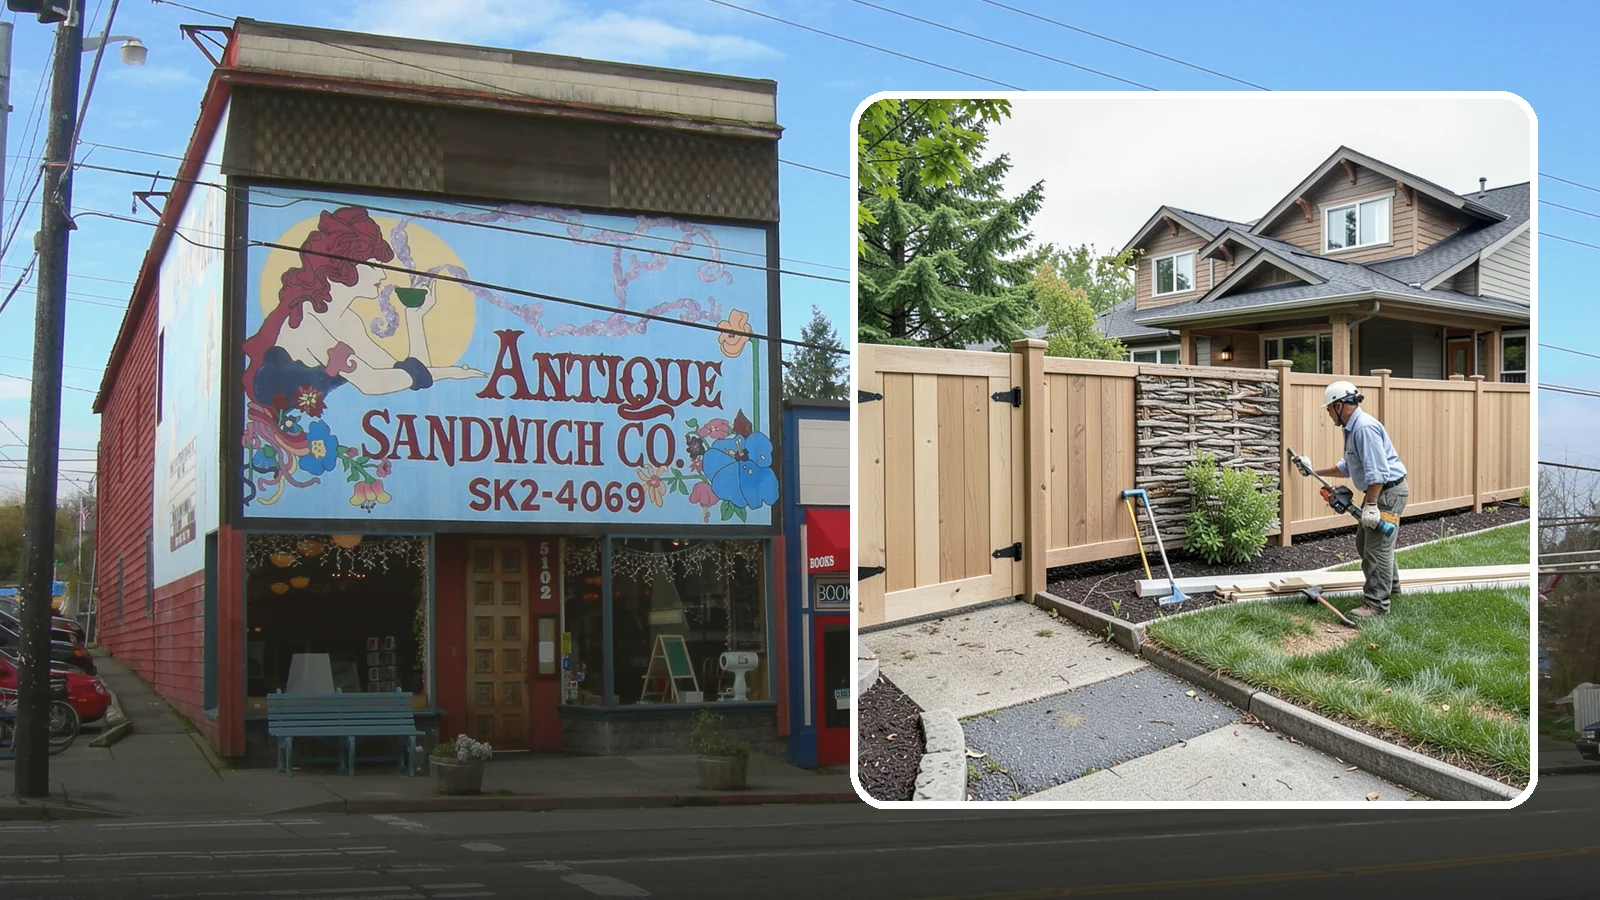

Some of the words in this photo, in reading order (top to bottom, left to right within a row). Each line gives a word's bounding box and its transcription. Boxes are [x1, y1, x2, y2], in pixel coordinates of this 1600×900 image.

[476, 330, 723, 420] ANTIQUE
[361, 408, 605, 467] SANDWICH
[617, 422, 686, 468] CO.
[468, 478, 646, 513] SK2-4069
[539, 541, 552, 599] 5102
[809, 555, 835, 568] BOOKS
